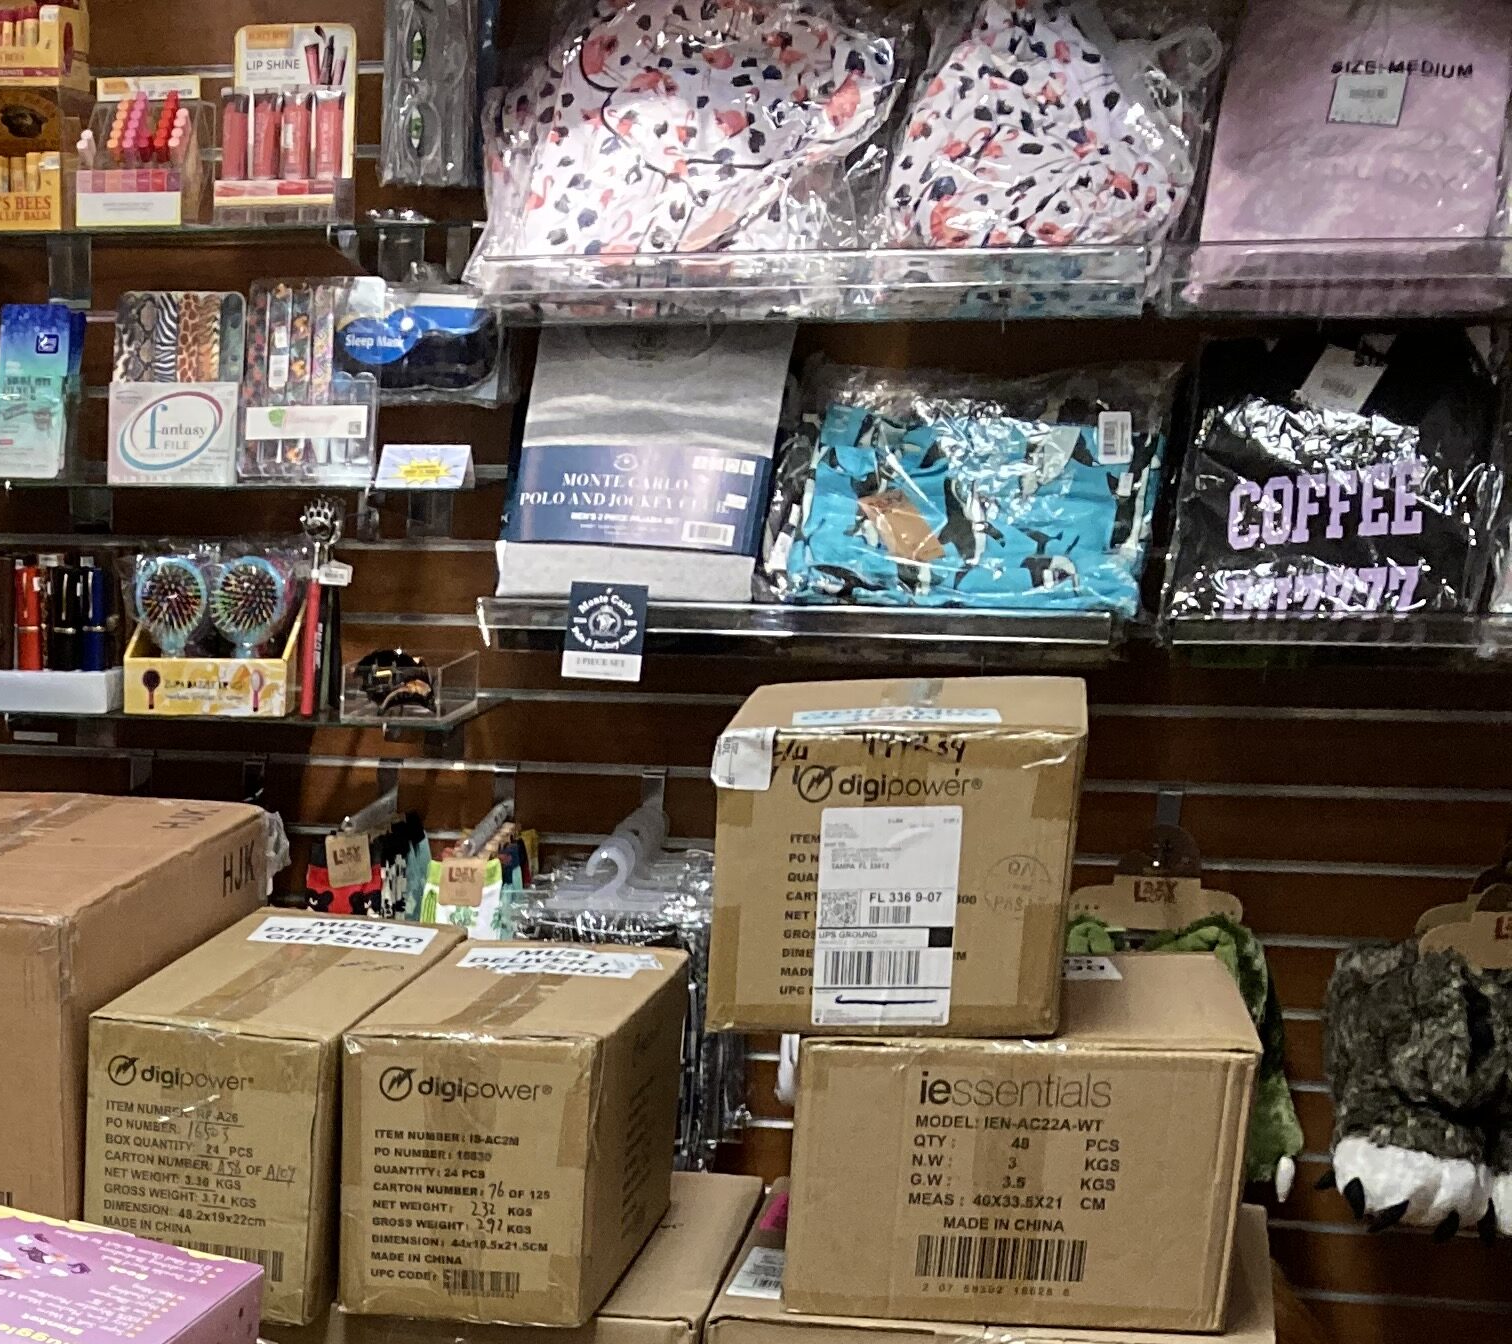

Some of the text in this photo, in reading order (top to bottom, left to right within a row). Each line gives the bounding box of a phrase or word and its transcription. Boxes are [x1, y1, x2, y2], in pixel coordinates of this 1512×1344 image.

[246, 59, 300, 70] LIP SHINE
[15, 195, 51, 211] BEES
[345, 333, 404, 350] Sleep Mask
[562, 473, 689, 491] MONTE CARLO
[519, 491, 565, 506] POLO
[564, 492, 606, 507] AND
[1228, 457, 1422, 550] COFFEE
[223, 841, 255, 897] HJK
[869, 892, 943, 903] FL 336 9-07
[311, 920, 389, 933] MUST
[264, 925, 425, 945] DELIVER TO
[265, 932, 413, 950] GIFT SHOP
[920, 1071, 1112, 1108] iessentials
[916, 1115, 1104, 1132] MODEL: IEN-AC22A-WT
[106, 1134, 130, 1145] BOX
[375, 1130, 404, 1139] ITEM
[1086, 1139, 1120, 1152] PCS
[104, 1184, 145, 1197] GROSS
[374, 1182, 422, 1193] CARTON
[1080, 1178, 1116, 1191] KGS
[103, 1216, 191, 1234] MADE IN CHINA
[943, 1216, 1065, 1232] MADE IN CHINA
[371, 1252, 462, 1265] MADE CHINA
